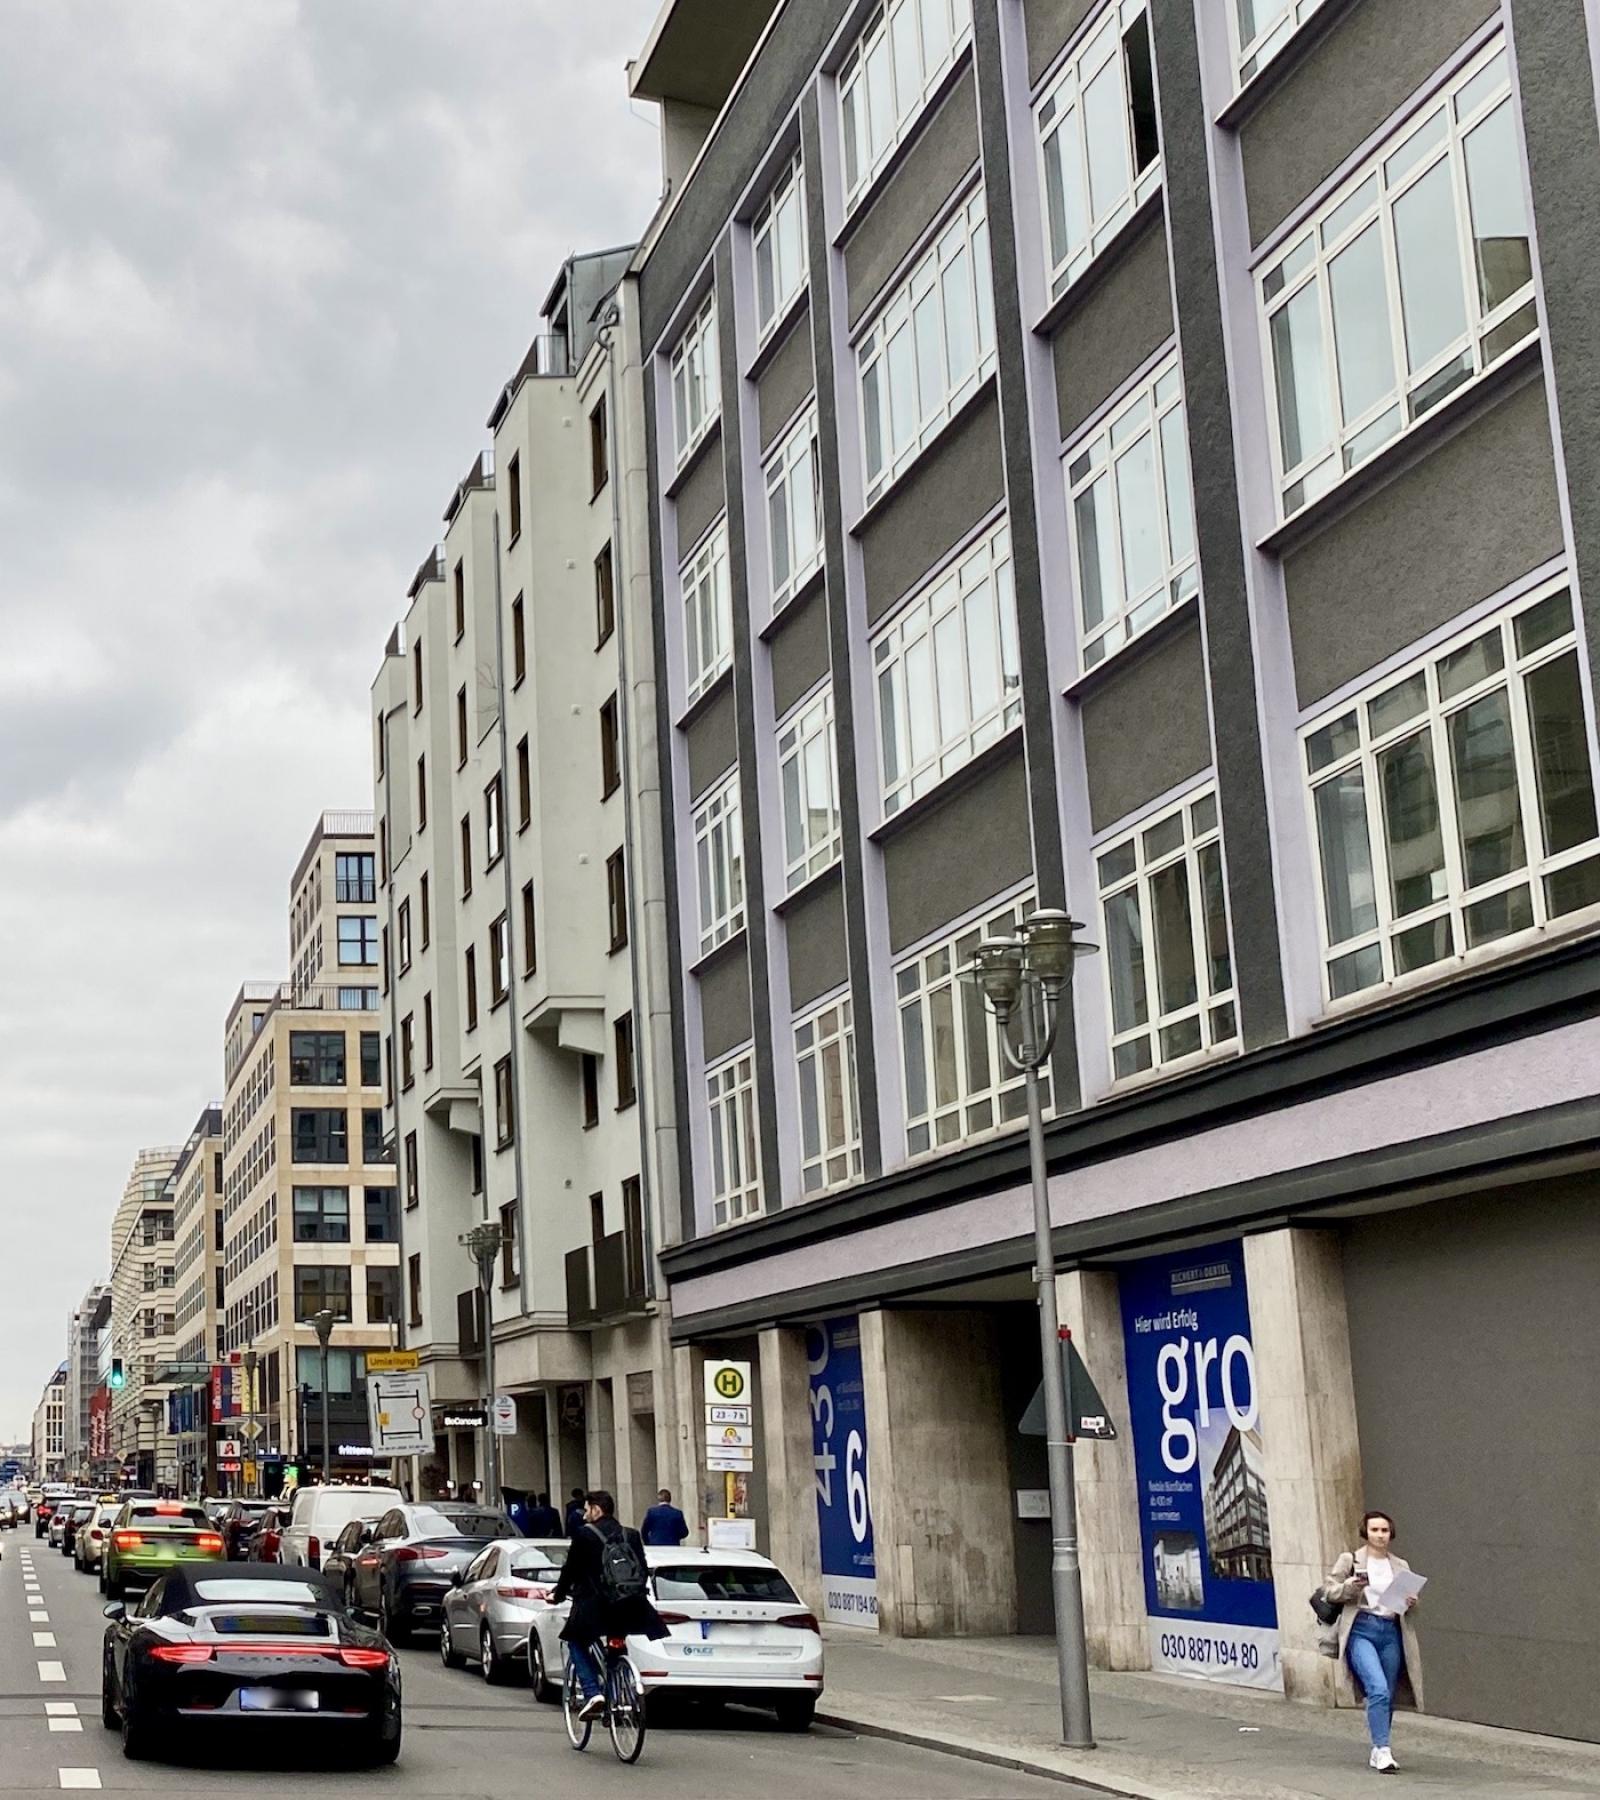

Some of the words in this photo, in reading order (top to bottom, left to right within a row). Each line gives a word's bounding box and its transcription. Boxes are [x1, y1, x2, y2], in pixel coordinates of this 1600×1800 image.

[1135, 1317, 1152, 1333] Hier
[1154, 1311, 1172, 1331] wird
[1173, 1307, 1199, 1331] Erfolg
[1161, 1633, 1186, 1659] 030
[1241, 1643, 1258, 1669] 80
